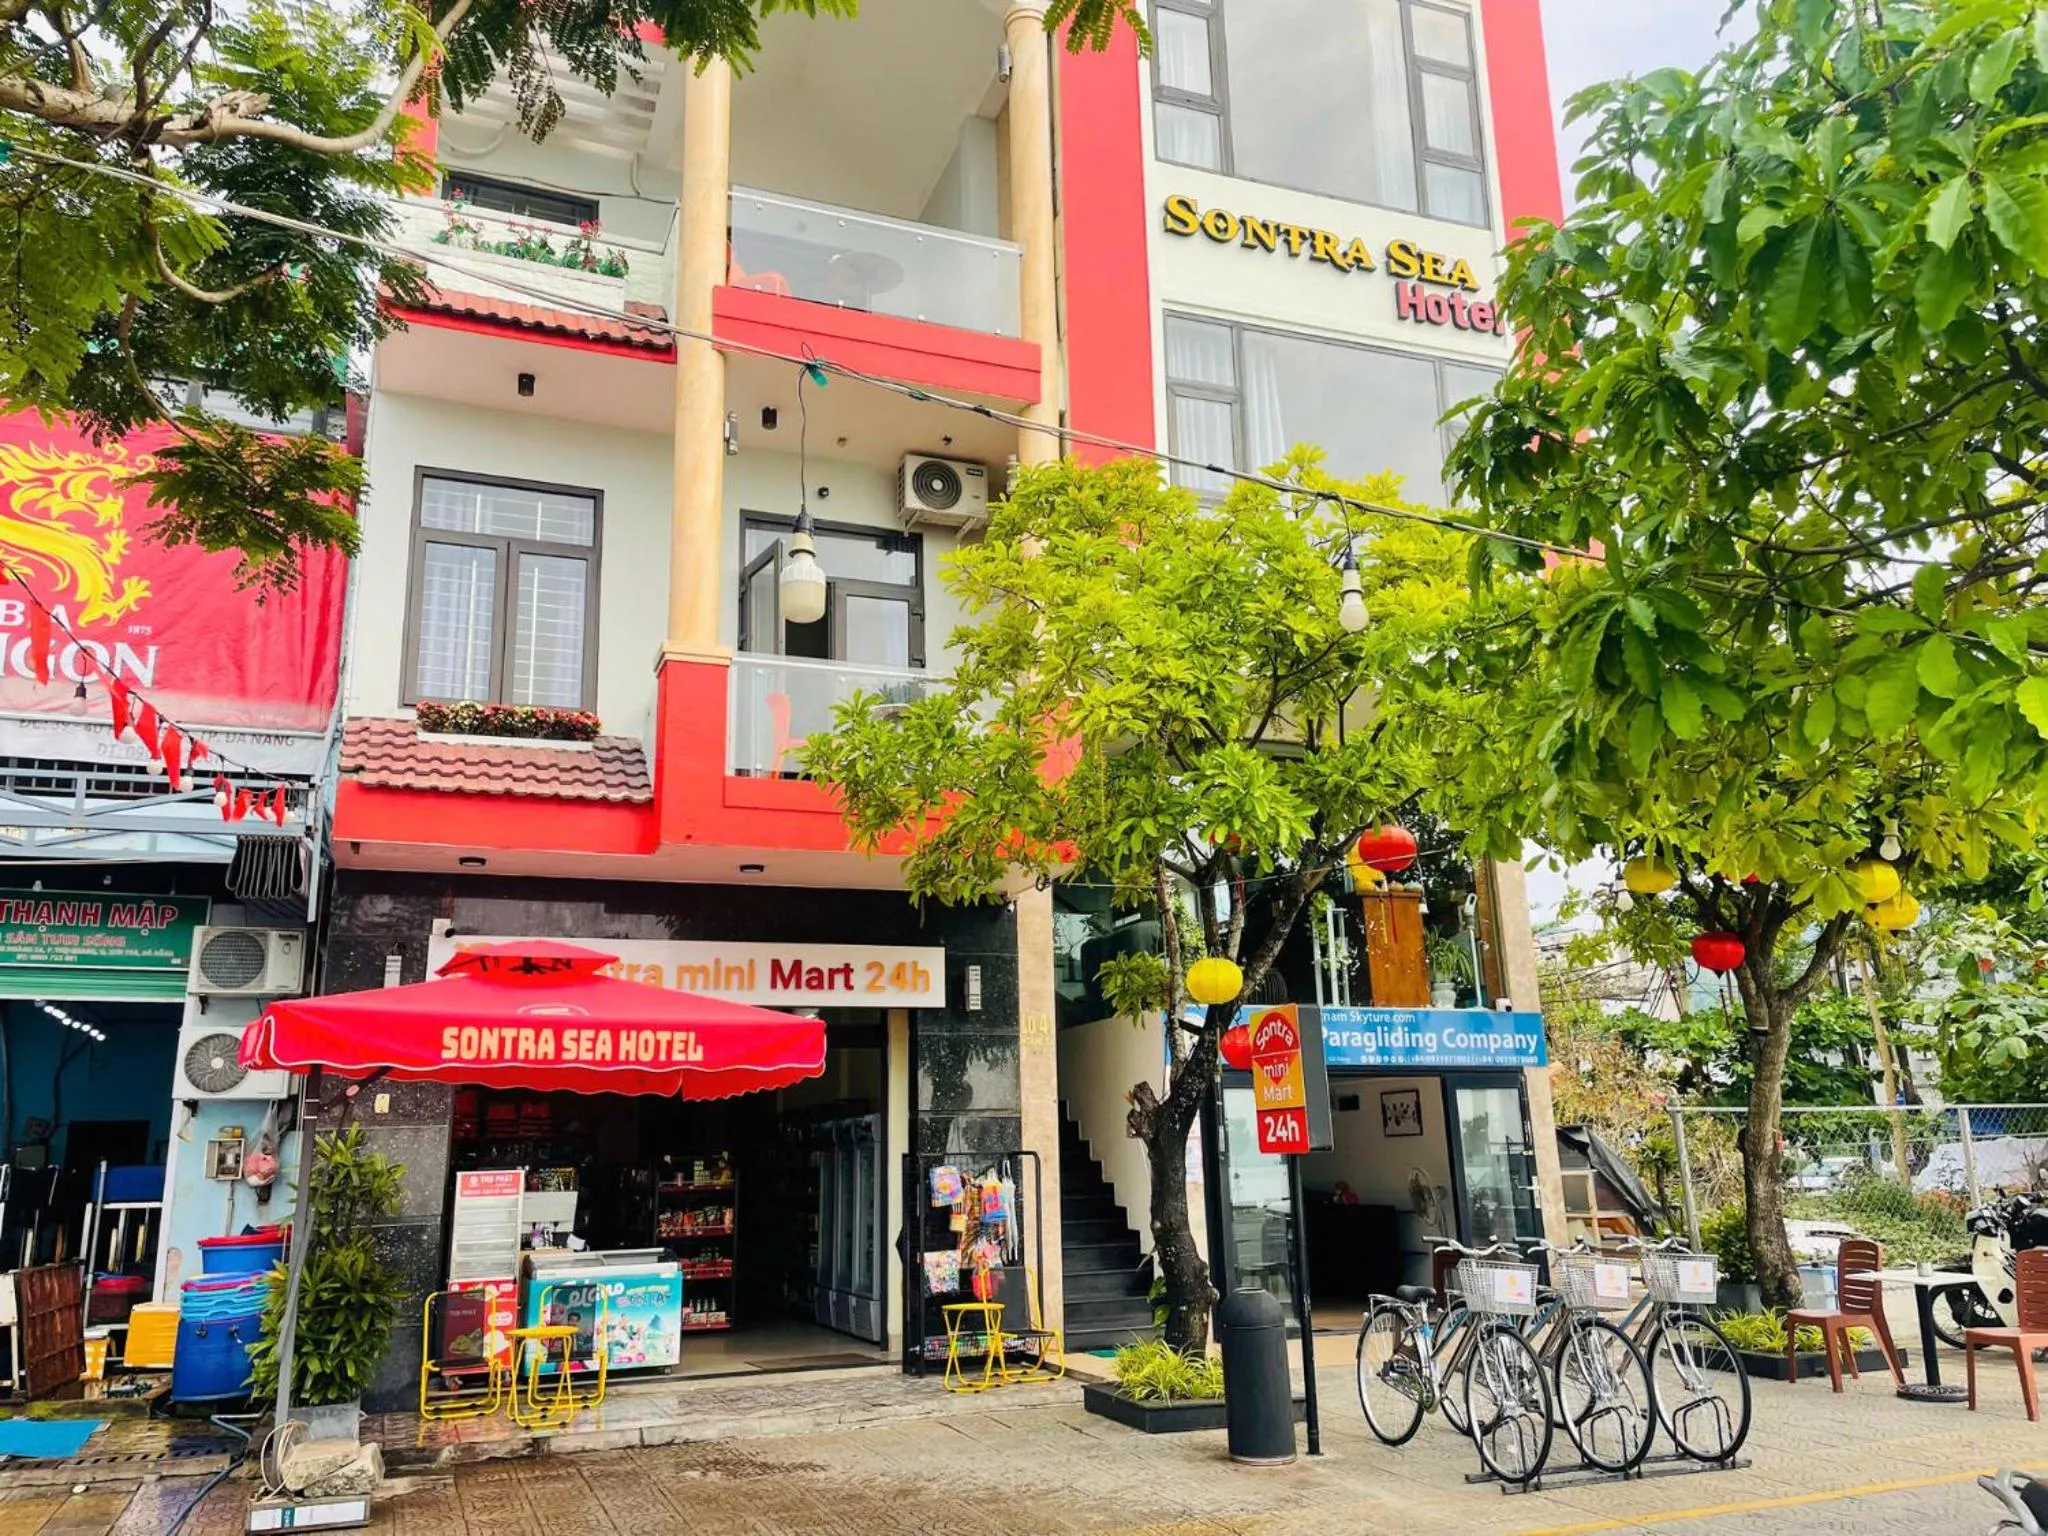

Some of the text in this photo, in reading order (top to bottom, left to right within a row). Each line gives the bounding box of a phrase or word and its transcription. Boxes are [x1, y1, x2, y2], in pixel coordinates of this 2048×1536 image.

[1163, 194, 1480, 292] SONTRA SEA
[1395, 281, 1506, 336] Hotel
[107, 900, 178, 937] MẬP
[676, 957, 756, 991] mini
[770, 959, 854, 991] Mart
[865, 960, 930, 993] 24h
[441, 1026, 704, 1062] SONTRA SEA HOTEL
[1442, 1027, 1538, 1054] Company
[1263, 1057, 1289, 1077] mini
[1263, 1085, 1293, 1101] Mart
[1265, 1113, 1300, 1143] 24h
